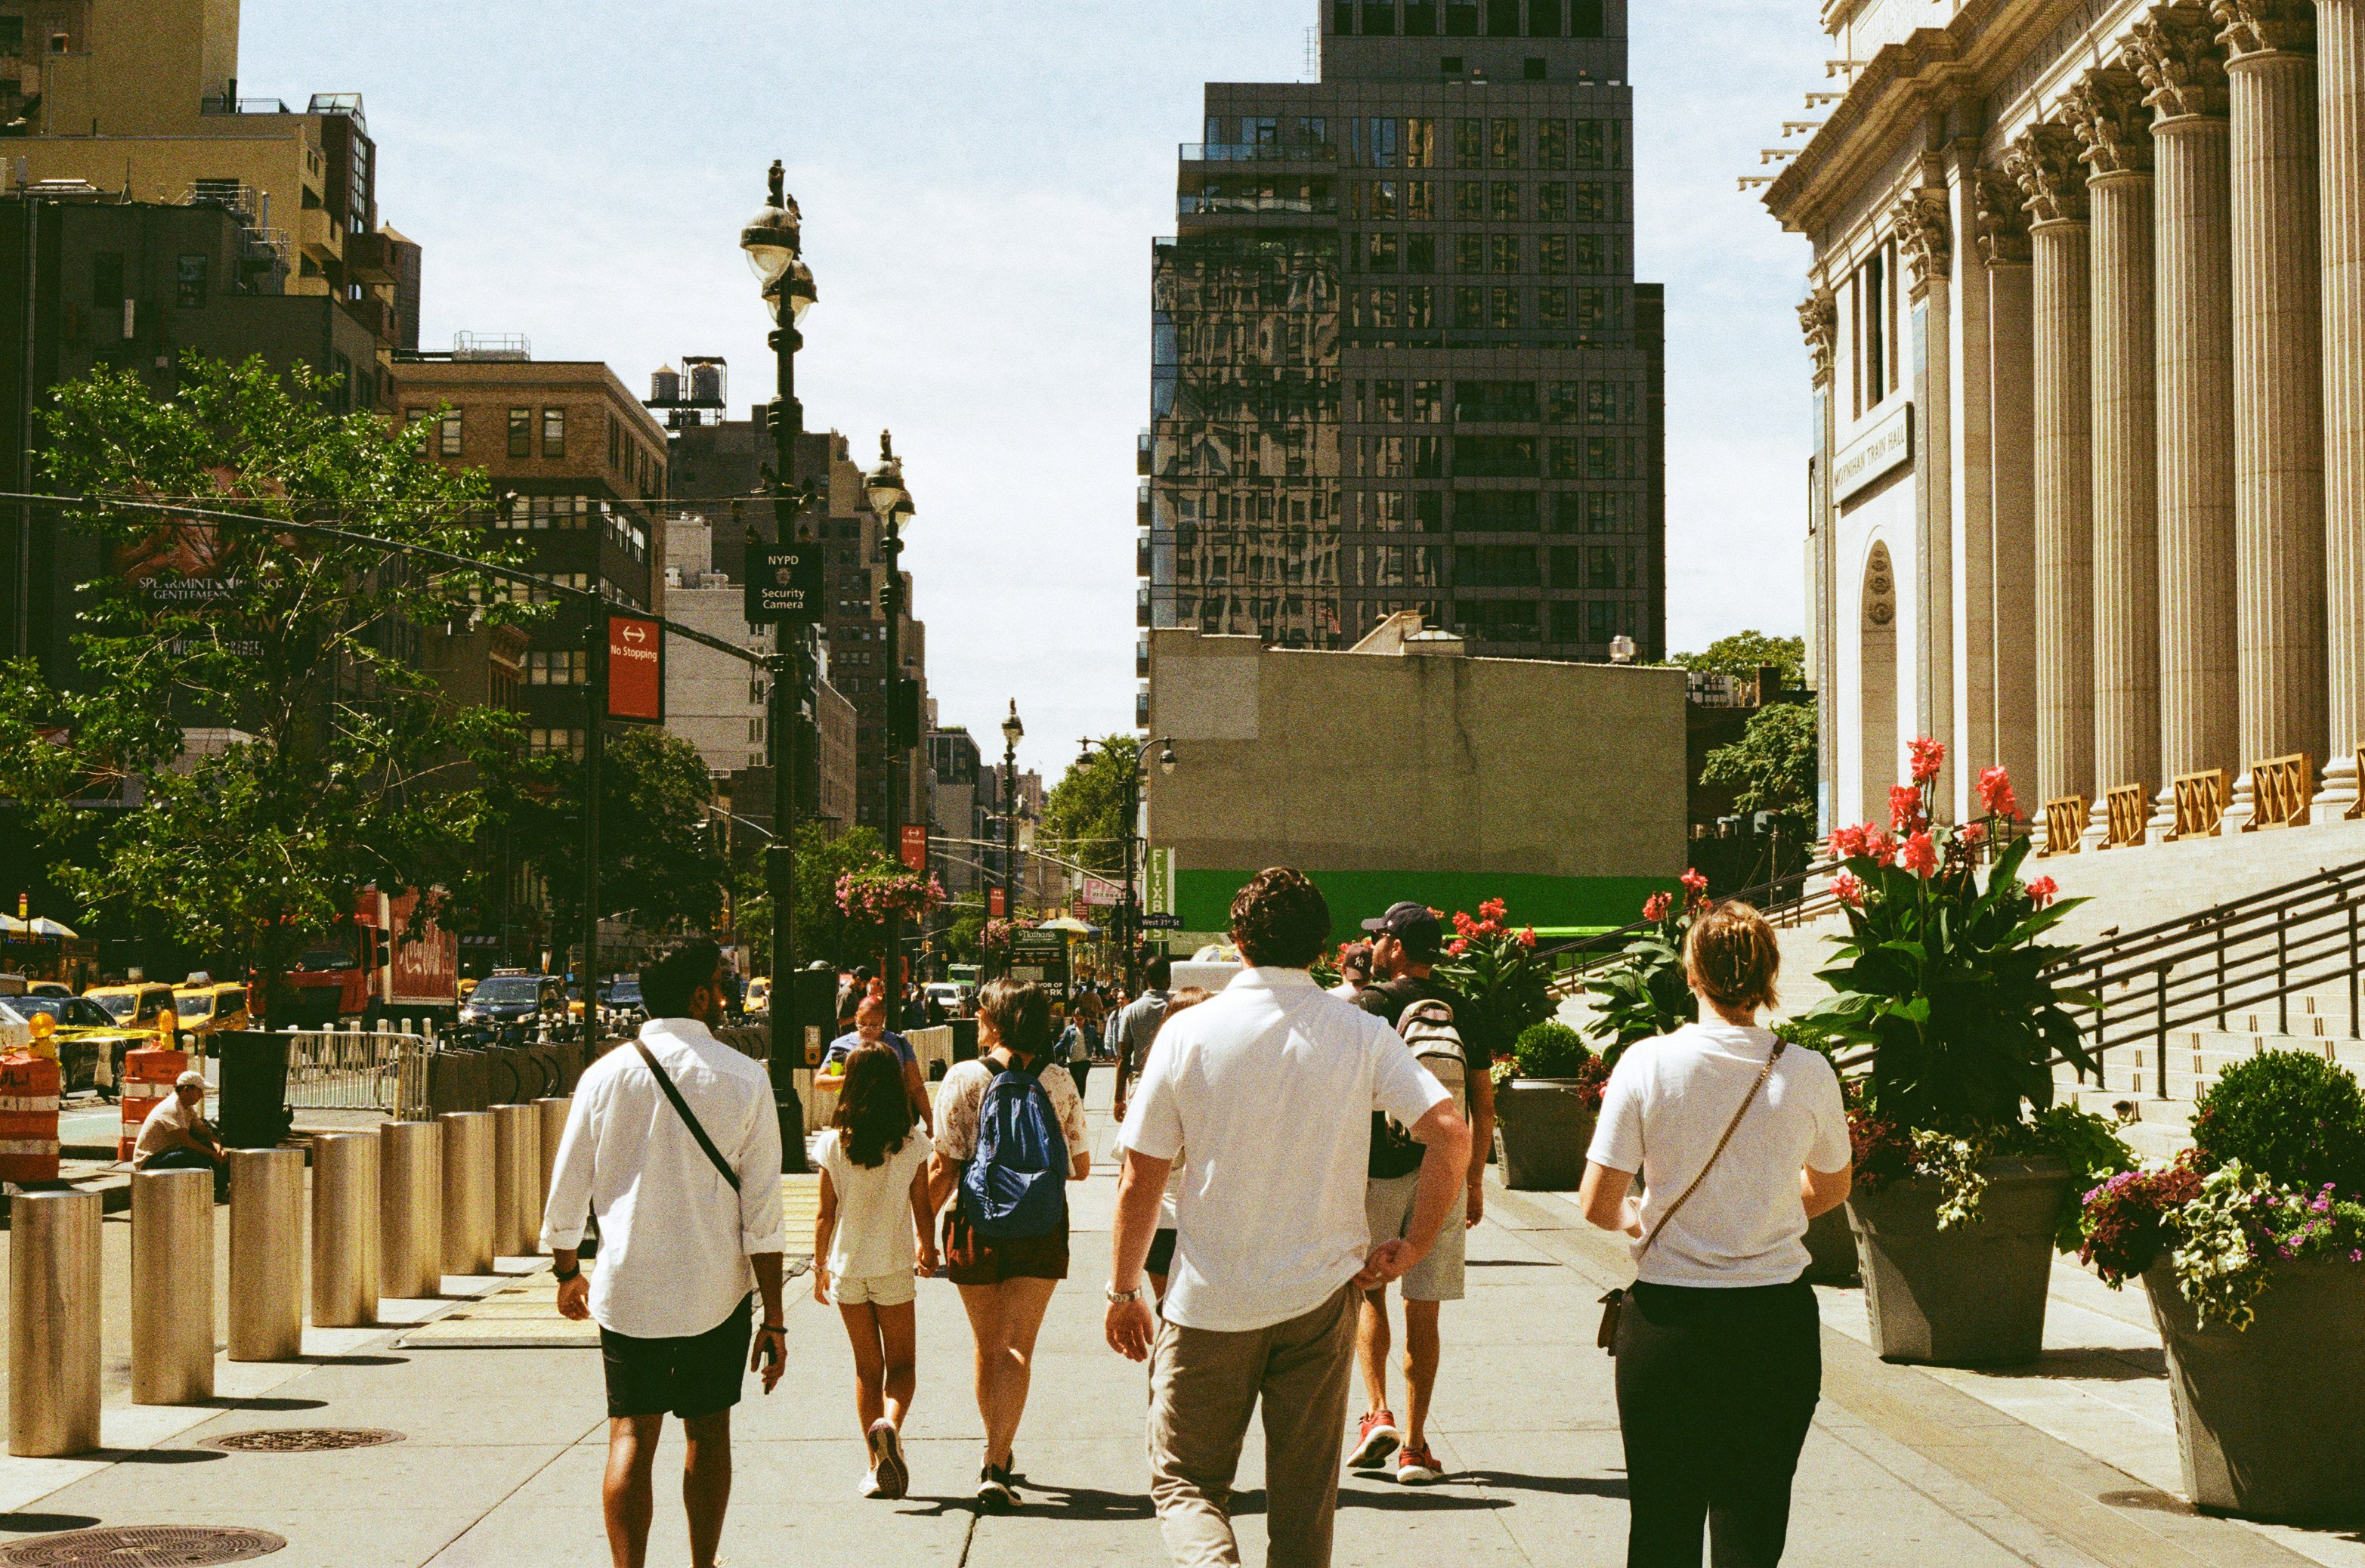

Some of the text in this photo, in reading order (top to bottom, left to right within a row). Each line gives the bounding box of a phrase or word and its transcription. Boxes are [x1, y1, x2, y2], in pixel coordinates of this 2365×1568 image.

[1834, 424, 1905, 487] MOYNIHAN TRAIN HALL
[768, 555, 799, 565] NYPD
[761, 588, 805, 600] Security
[762, 599, 804, 609] Camera
[610, 644, 658, 663] No Stopping
[1152, 849, 1164, 939] FLiXBS
[1142, 918, 1159, 926] West
[1173, 918, 1180, 926] St
[1050, 988, 1063, 996] RK
